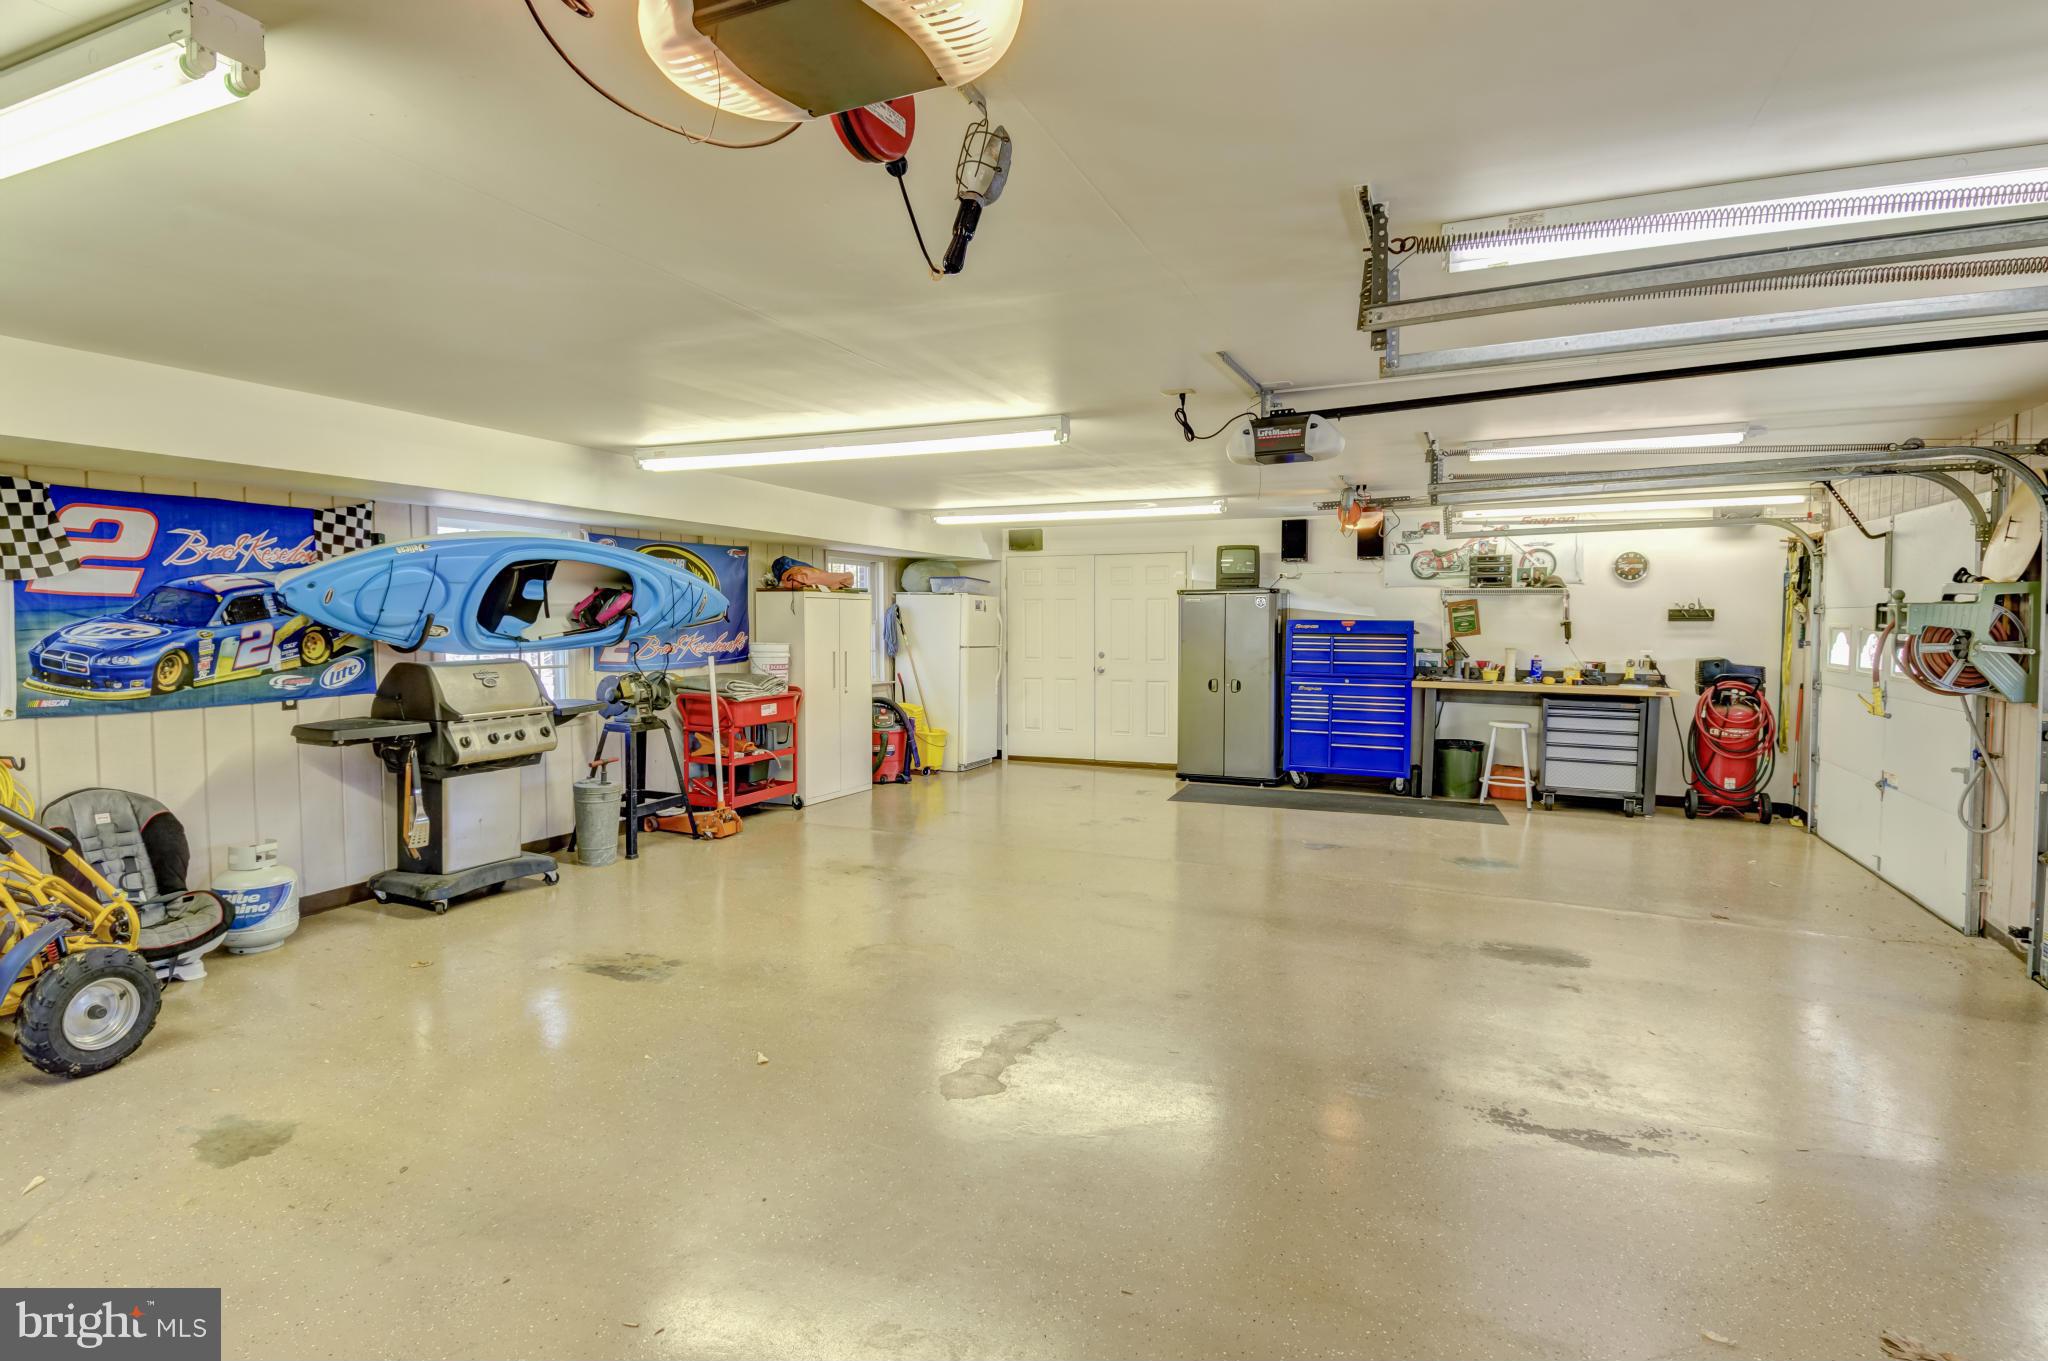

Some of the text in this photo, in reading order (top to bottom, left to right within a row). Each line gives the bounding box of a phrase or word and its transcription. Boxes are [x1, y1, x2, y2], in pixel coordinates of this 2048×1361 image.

[1257, 428, 1301, 437] LiftMaster
[1520, 514, 1577, 526] Snap-on
[25, 502, 160, 598] 2
[162, 528, 249, 567] Brad
[232, 622, 275, 671] 2
[235, 902, 271, 914] ino
